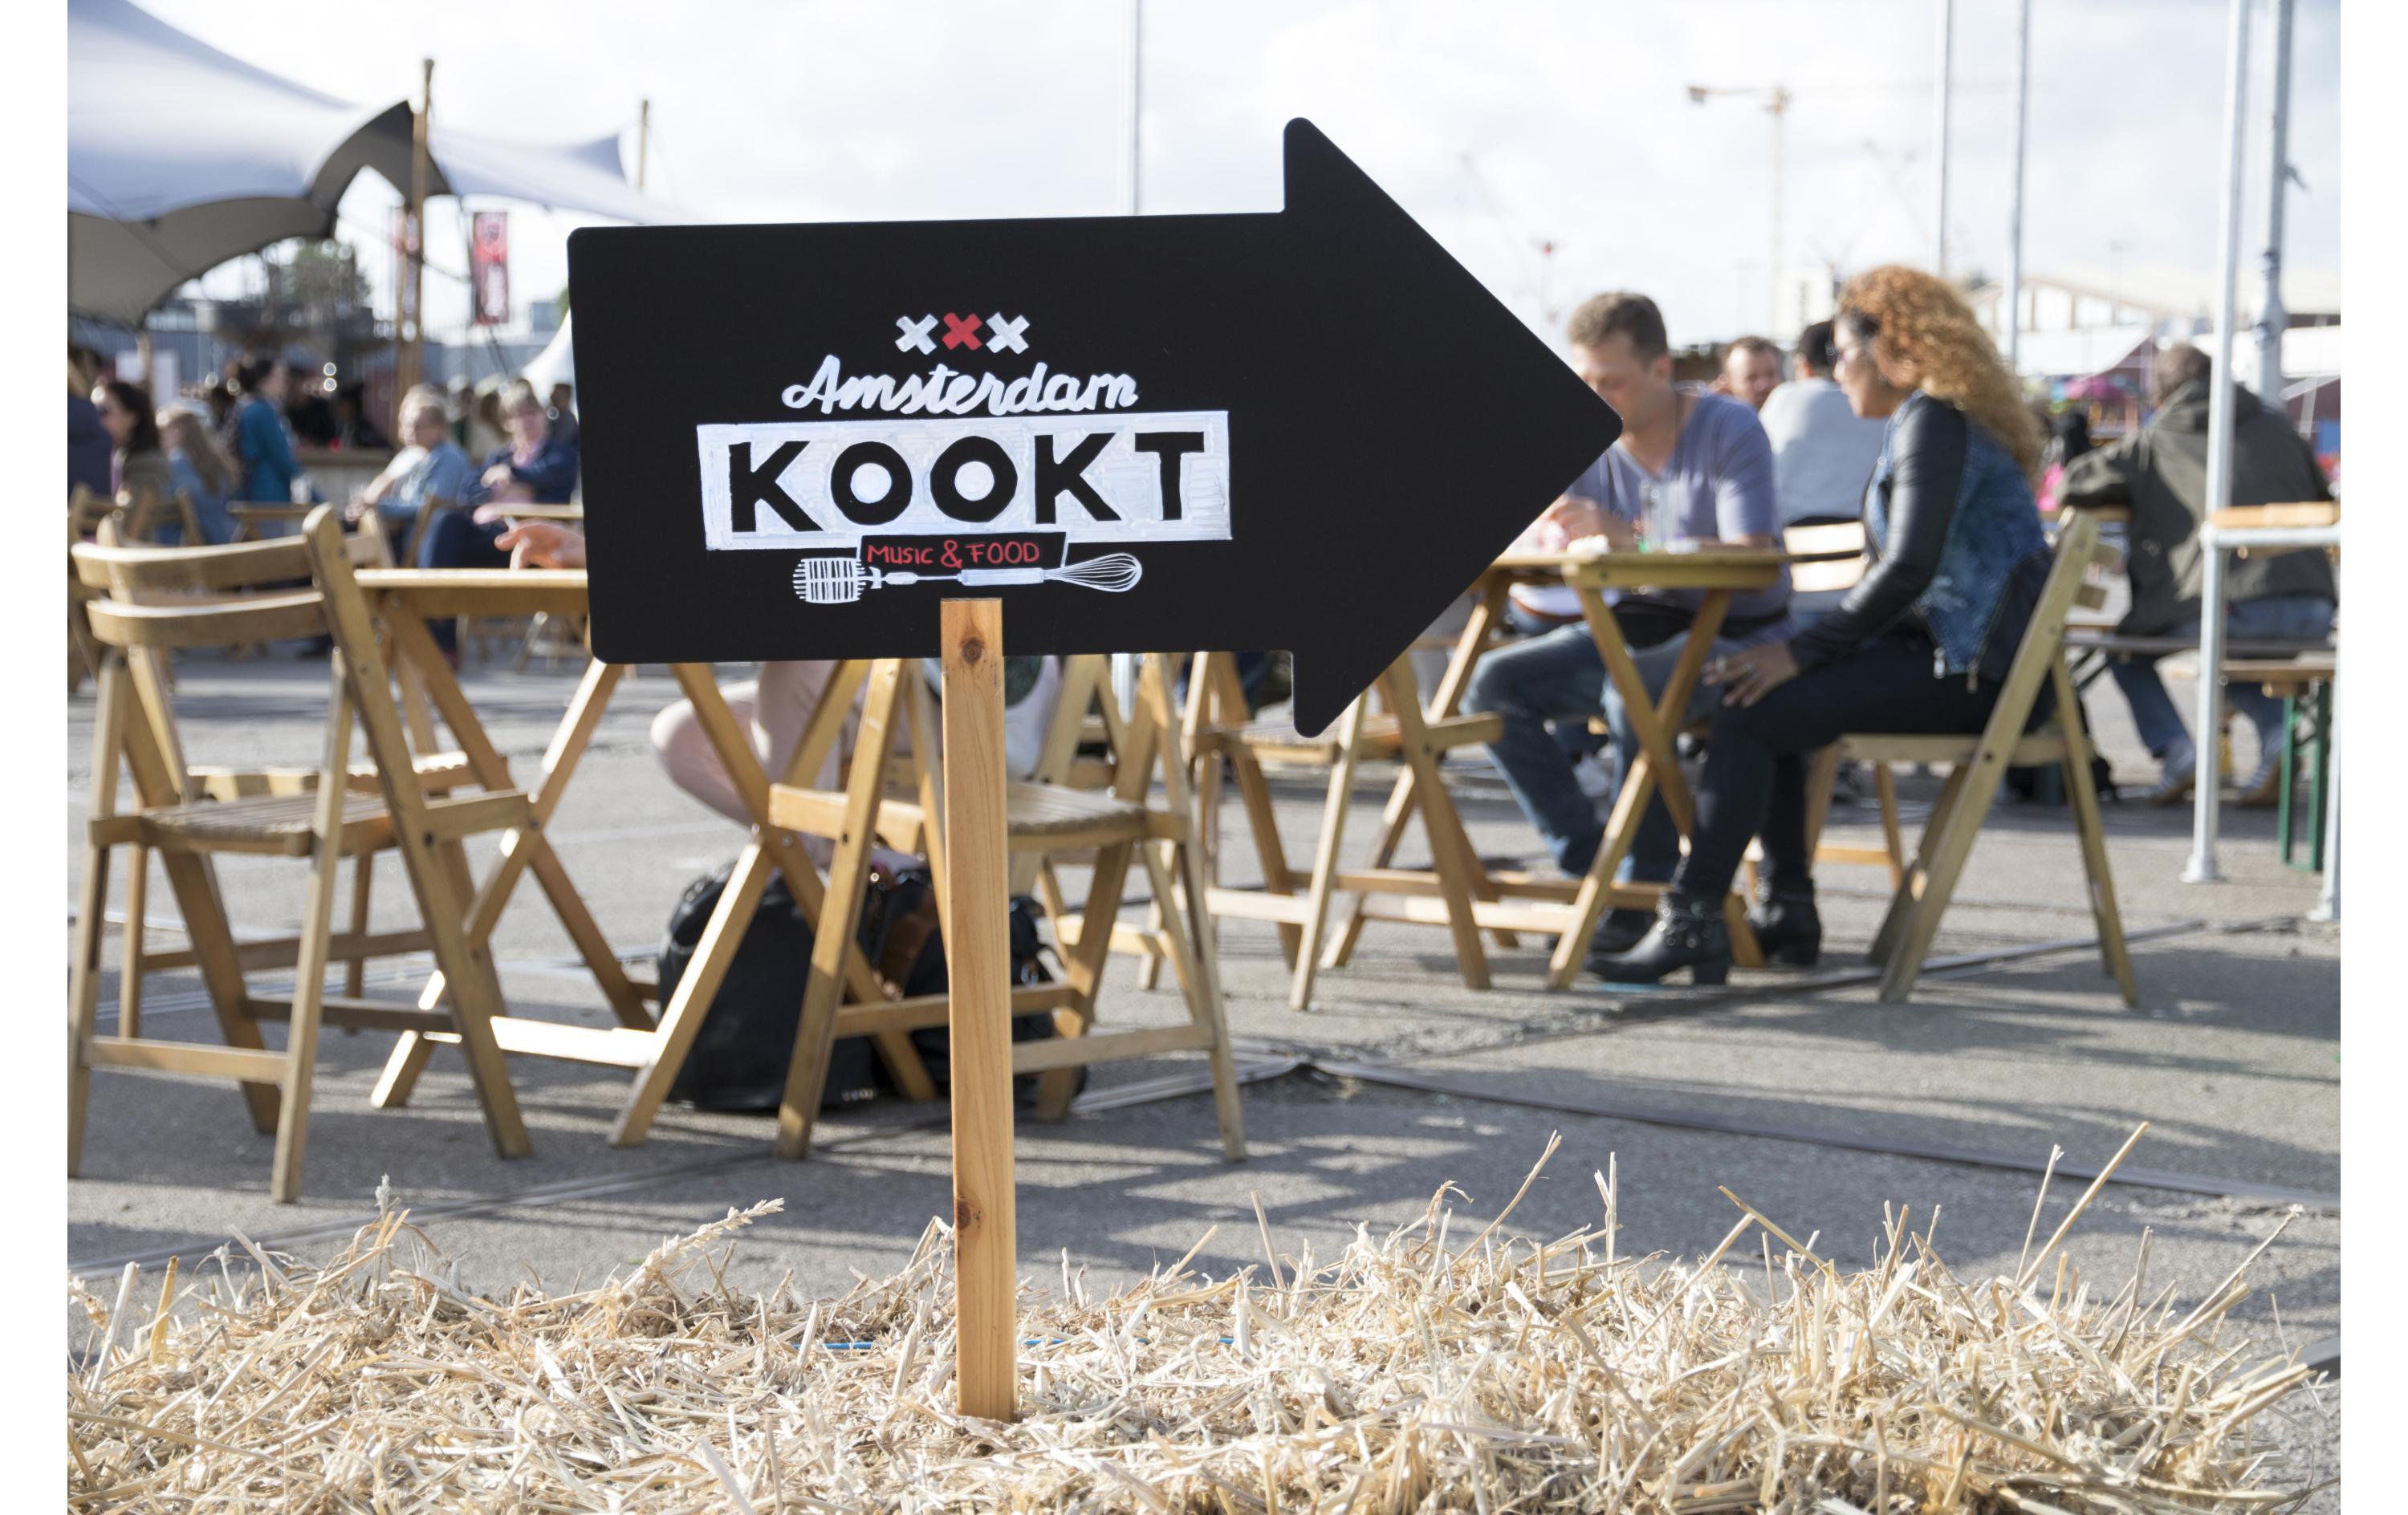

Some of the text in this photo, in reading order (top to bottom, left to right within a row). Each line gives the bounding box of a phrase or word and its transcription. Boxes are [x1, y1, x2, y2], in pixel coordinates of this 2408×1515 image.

[781, 354, 1140, 416] Amsterdam
[727, 430, 1206, 533] KOOKT
[866, 538, 1041, 568] MUSIC & FOOD
